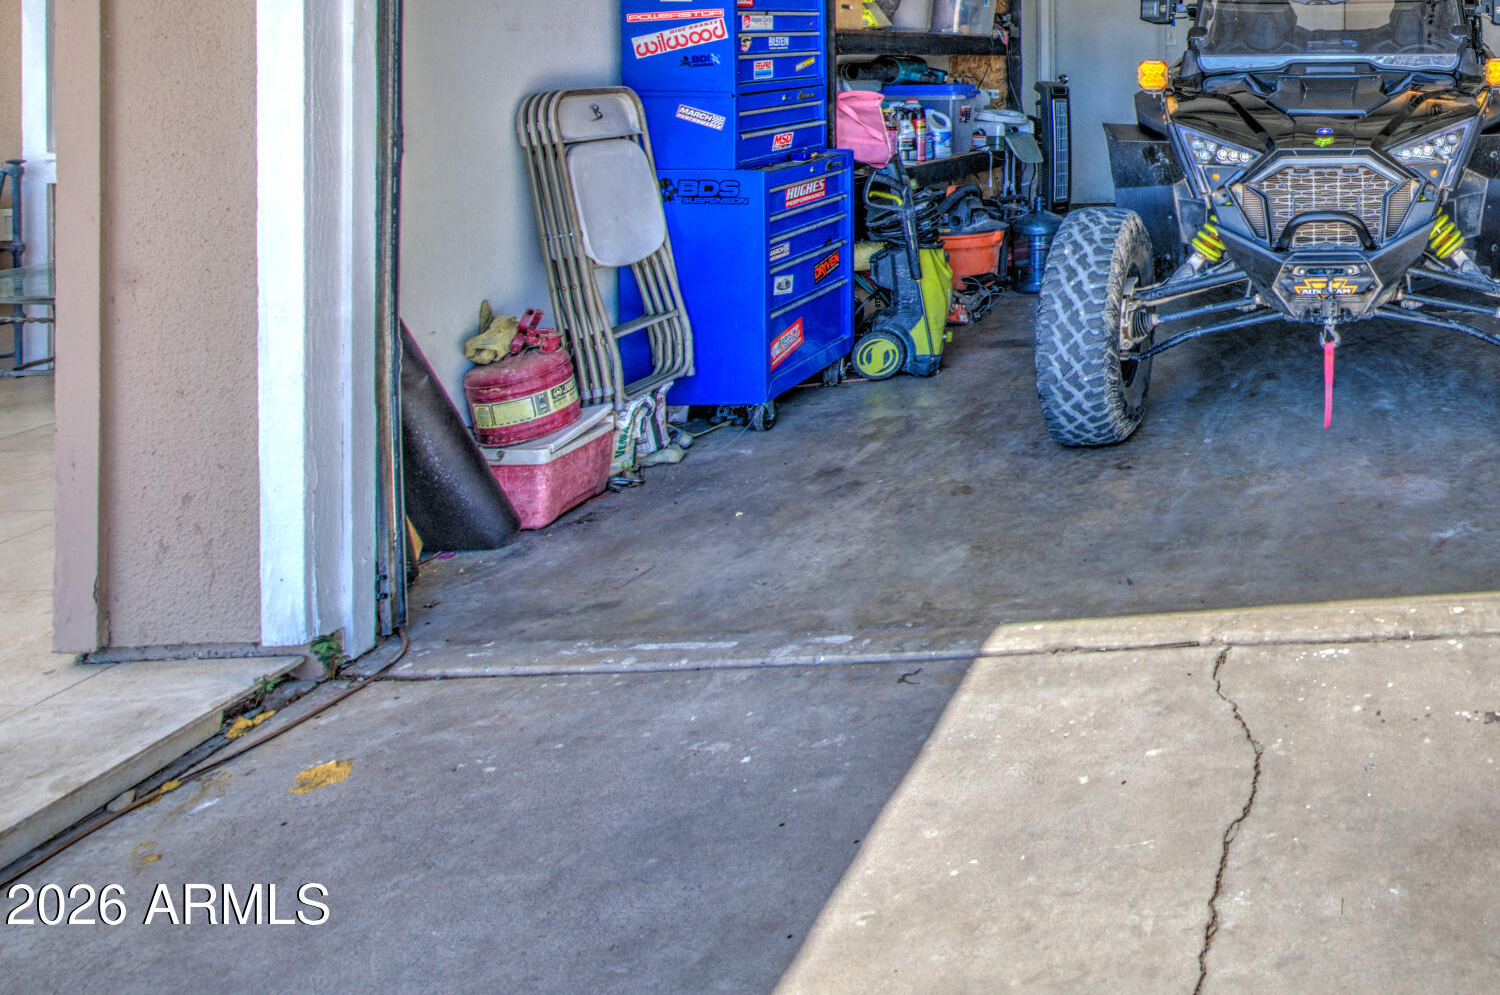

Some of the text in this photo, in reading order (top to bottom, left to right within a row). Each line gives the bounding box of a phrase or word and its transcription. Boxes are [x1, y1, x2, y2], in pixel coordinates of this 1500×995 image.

[635, 18, 726, 57] wilwood
[768, 36, 789, 46] BILSTEIN
[679, 106, 713, 123] MARCH
[774, 133, 793, 144] MSD
[677, 179, 741, 198] BDS
[785, 179, 825, 201] HUGHES
[681, 197, 749, 205] SUSPENSION
[814, 252, 839, 280] DRIVEN
